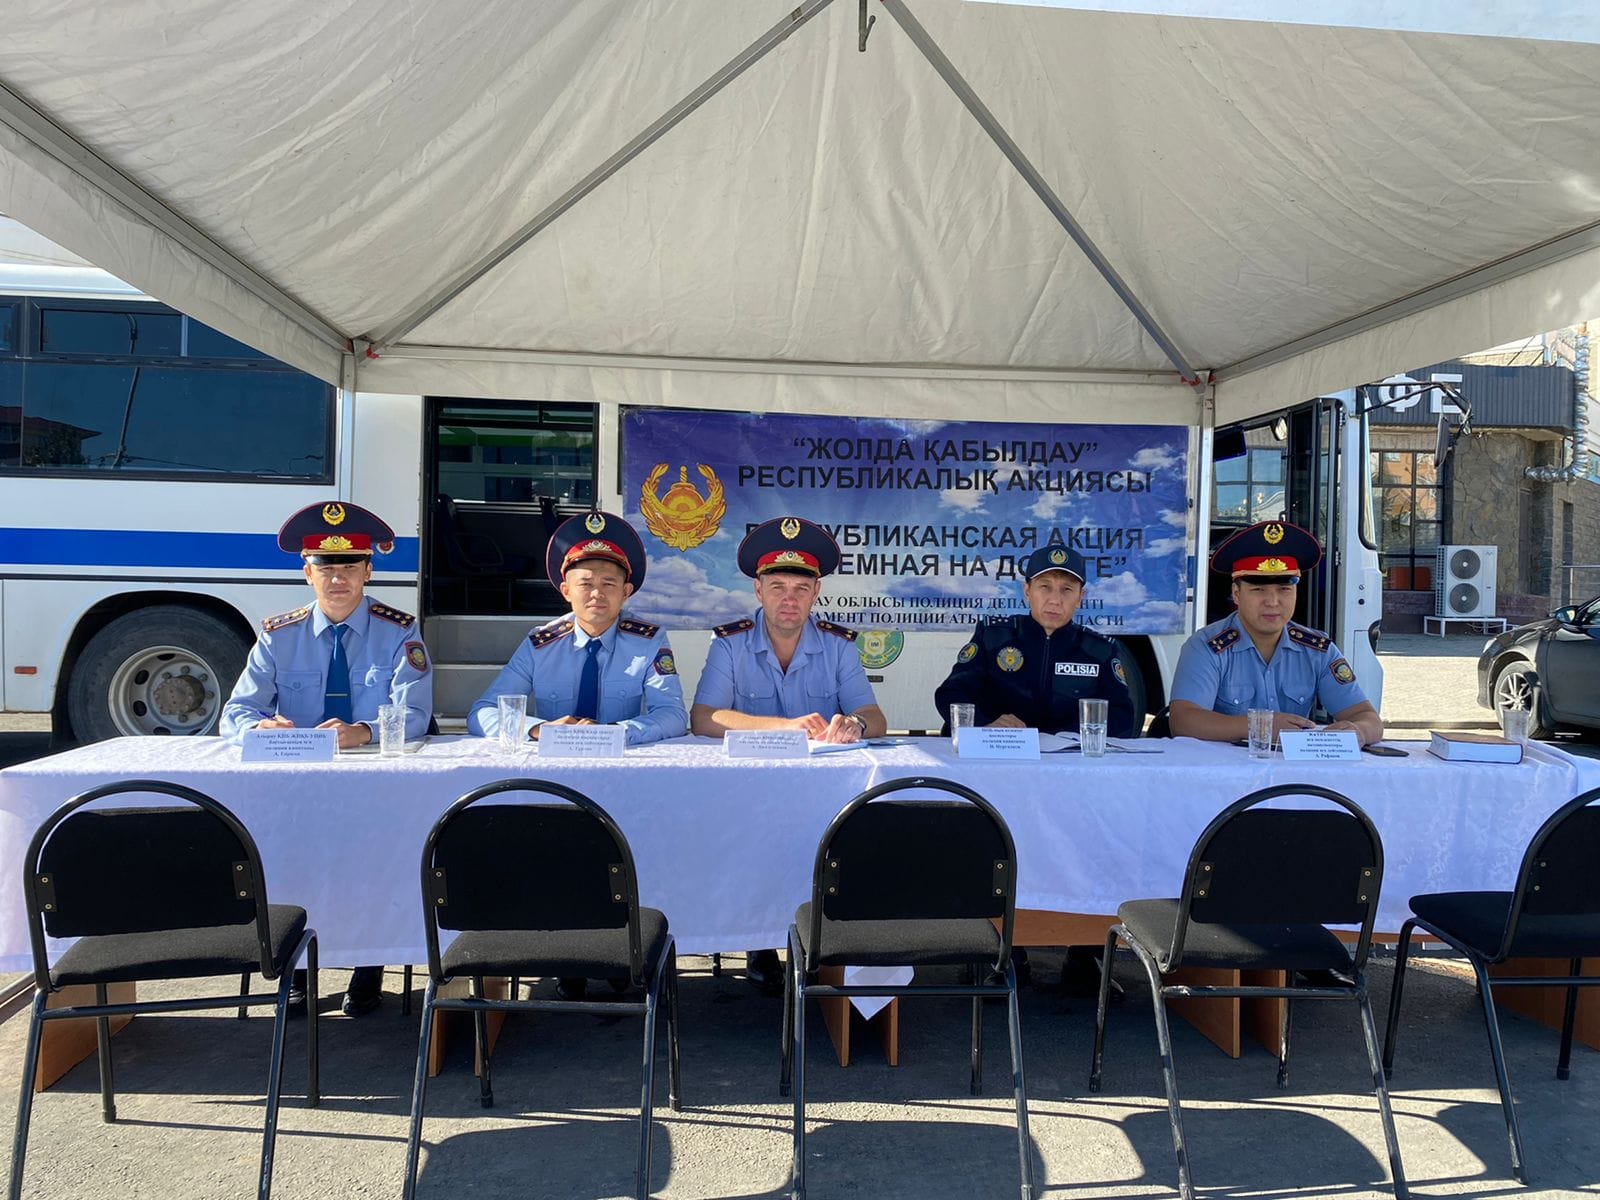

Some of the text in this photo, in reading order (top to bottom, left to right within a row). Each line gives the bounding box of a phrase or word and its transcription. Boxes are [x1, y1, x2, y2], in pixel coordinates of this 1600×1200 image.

[1378, 373, 1463, 413] ФЕ
[738, 465, 1152, 495] РЕСПУБЛИКАЛЫҚ АКЦИЯСЫ
[745, 523, 1143, 553] УБЛИКАНСКАЯ АКЦИЯ
[830, 553, 939, 576] ЕМНАЯ
[949, 554, 989, 577] НА
[837, 596, 905, 608] ОБЛЫСЫ
[910, 597, 983, 609] ПОЛИЦИЯ
[870, 612, 945, 625] ПОЛИЦИИ
[1075, 614, 1124, 626] ЛАСТИ
[1057, 664, 1097, 674] POLISIA
